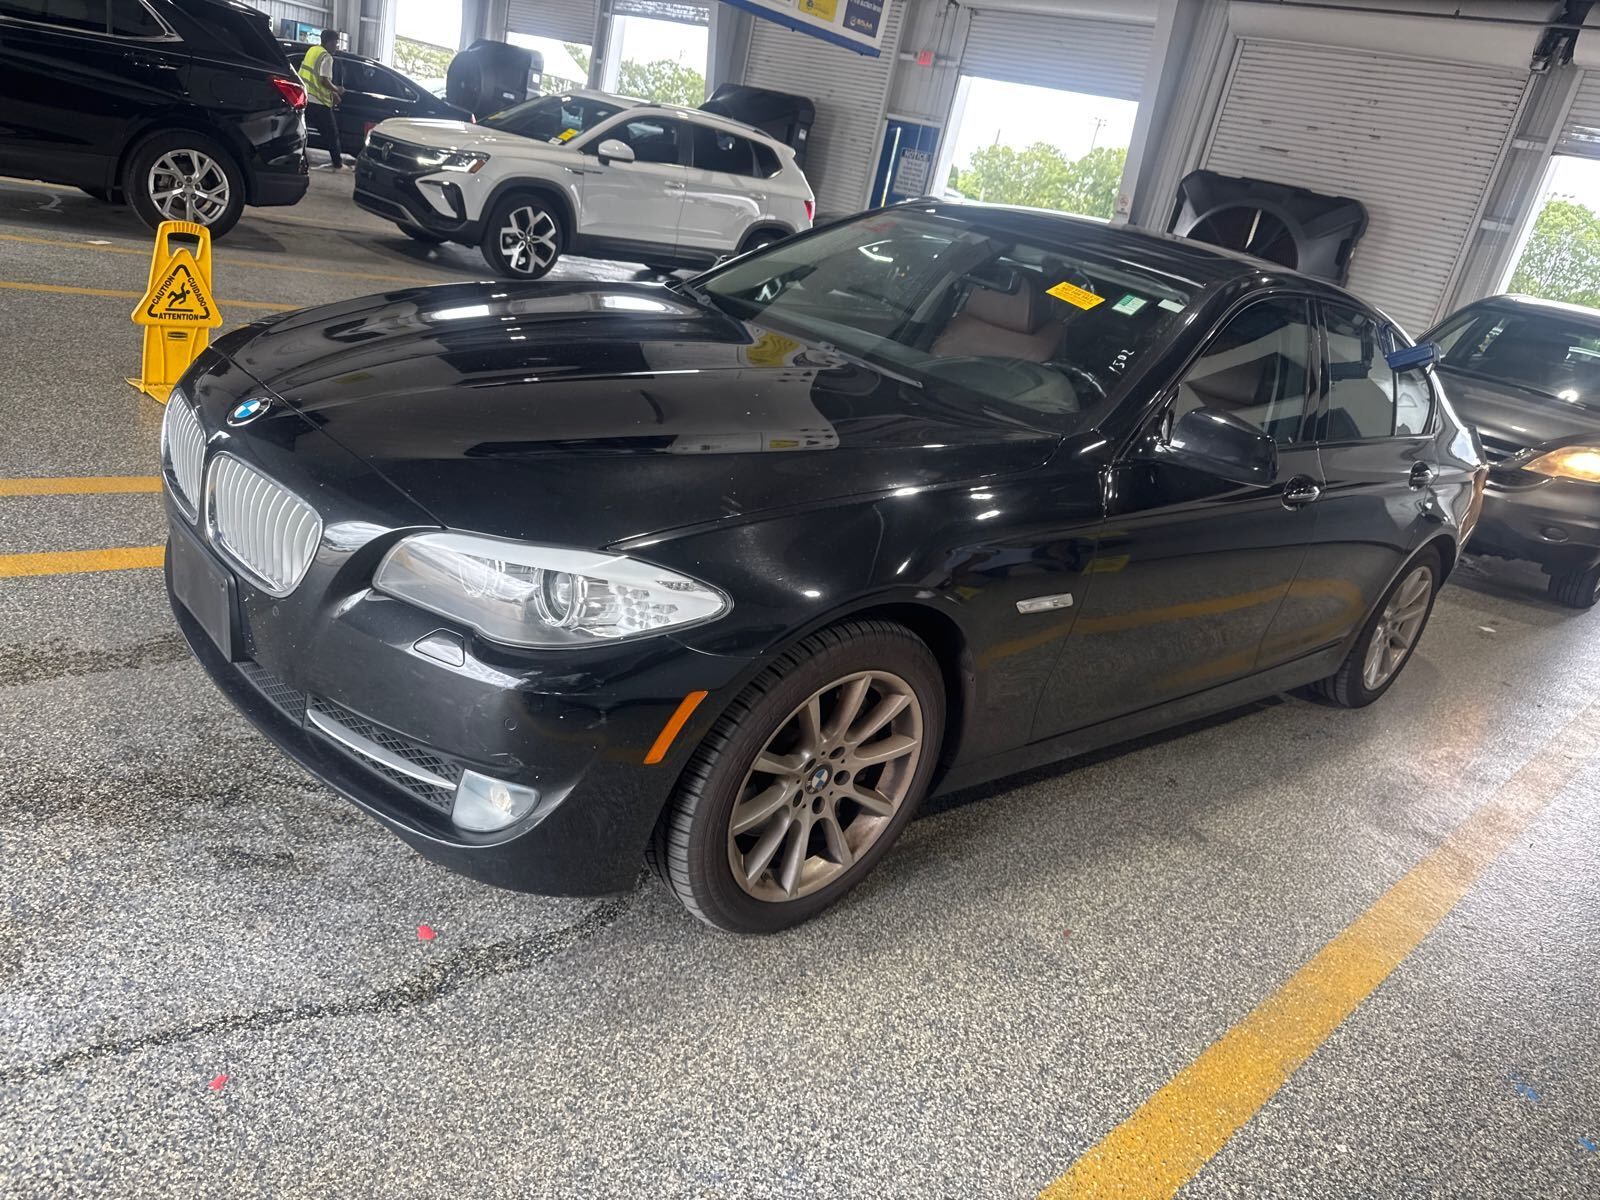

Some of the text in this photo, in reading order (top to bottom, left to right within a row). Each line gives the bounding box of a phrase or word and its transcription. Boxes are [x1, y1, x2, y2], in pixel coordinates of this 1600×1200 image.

[904, 149, 928, 162] NOTICE
[152, 275, 175, 305] CAUTION
[187, 276, 207, 307] CUIDADO
[158, 312, 199, 320] ATTENTION
